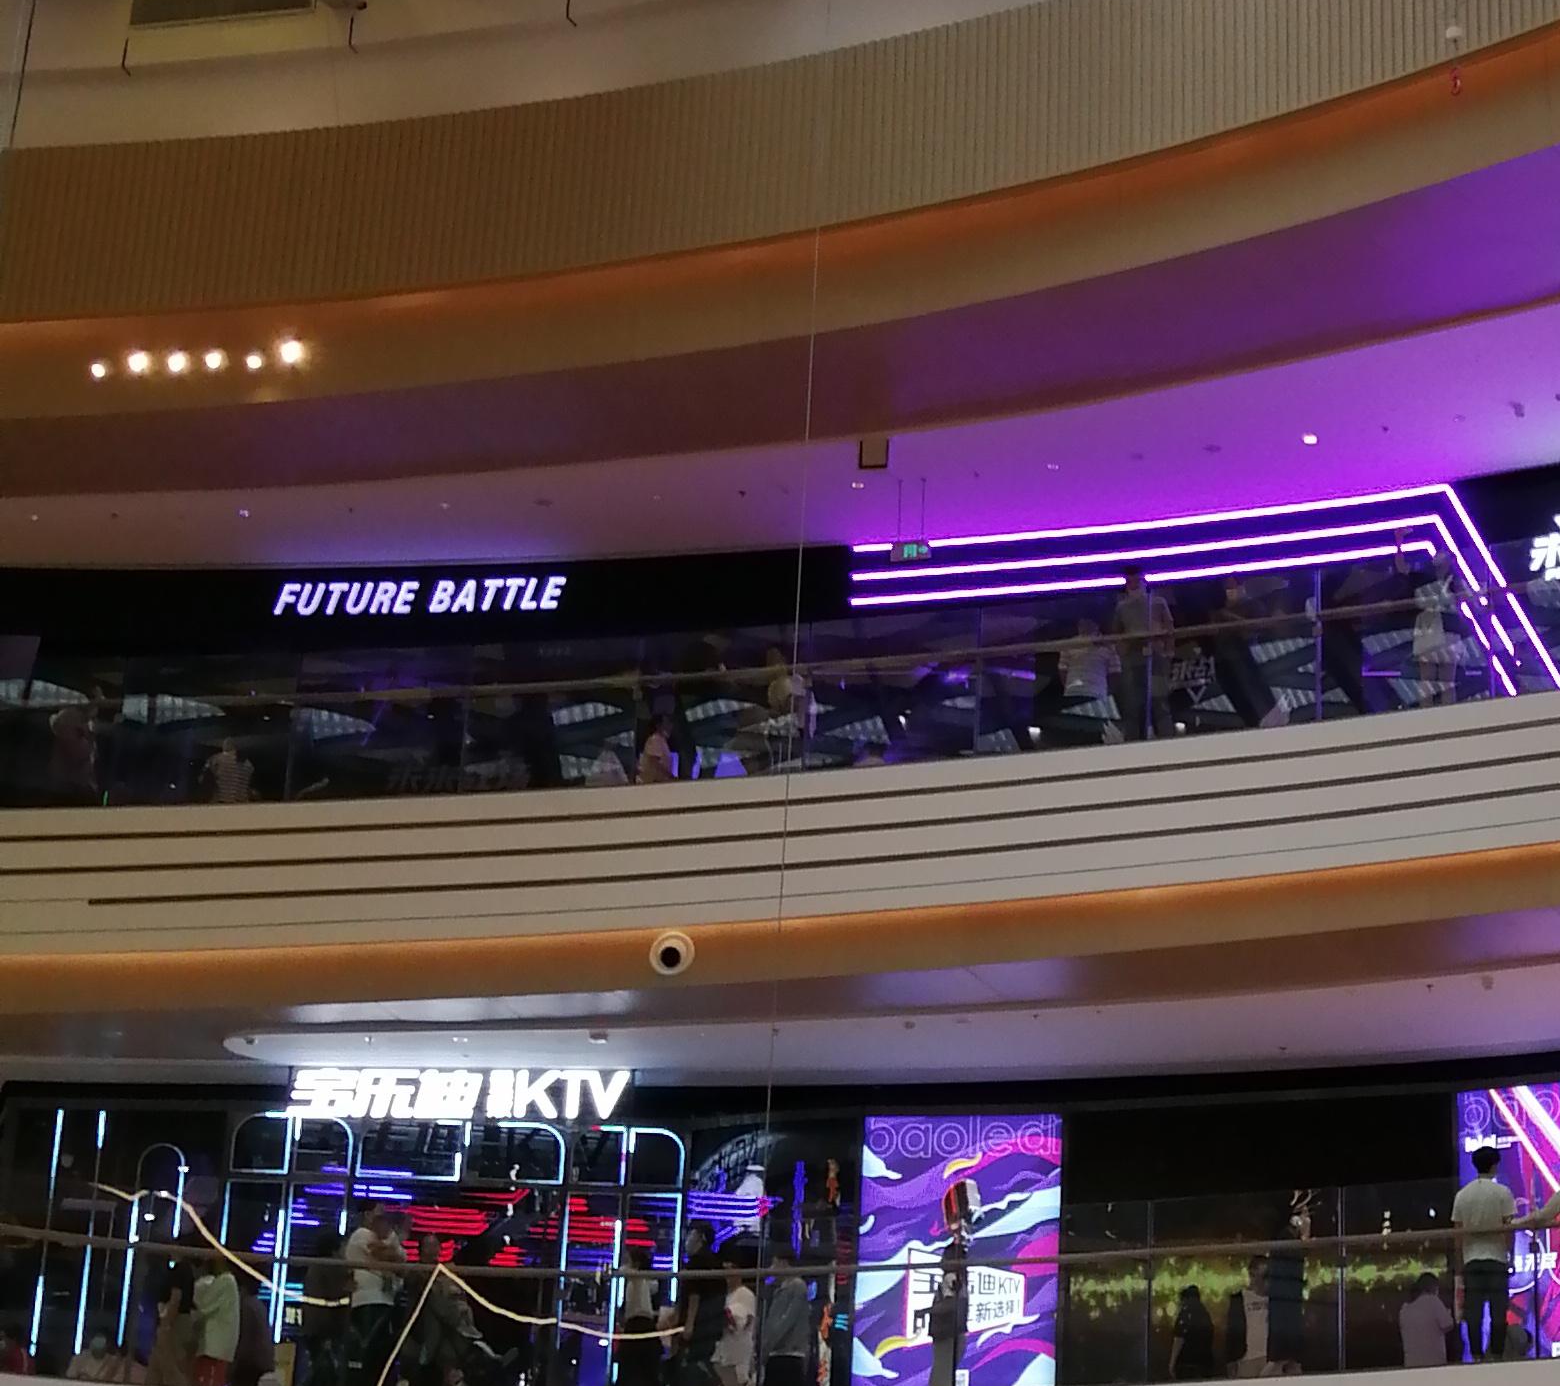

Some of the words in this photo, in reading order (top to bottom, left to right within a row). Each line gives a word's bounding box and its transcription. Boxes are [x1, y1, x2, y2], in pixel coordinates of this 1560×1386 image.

[272, 580, 421, 616] FUTURE
[428, 575, 568, 613] BATTLE
[285, 1067, 484, 1120] 宝乐迪
[513, 1069, 632, 1120] KTV
